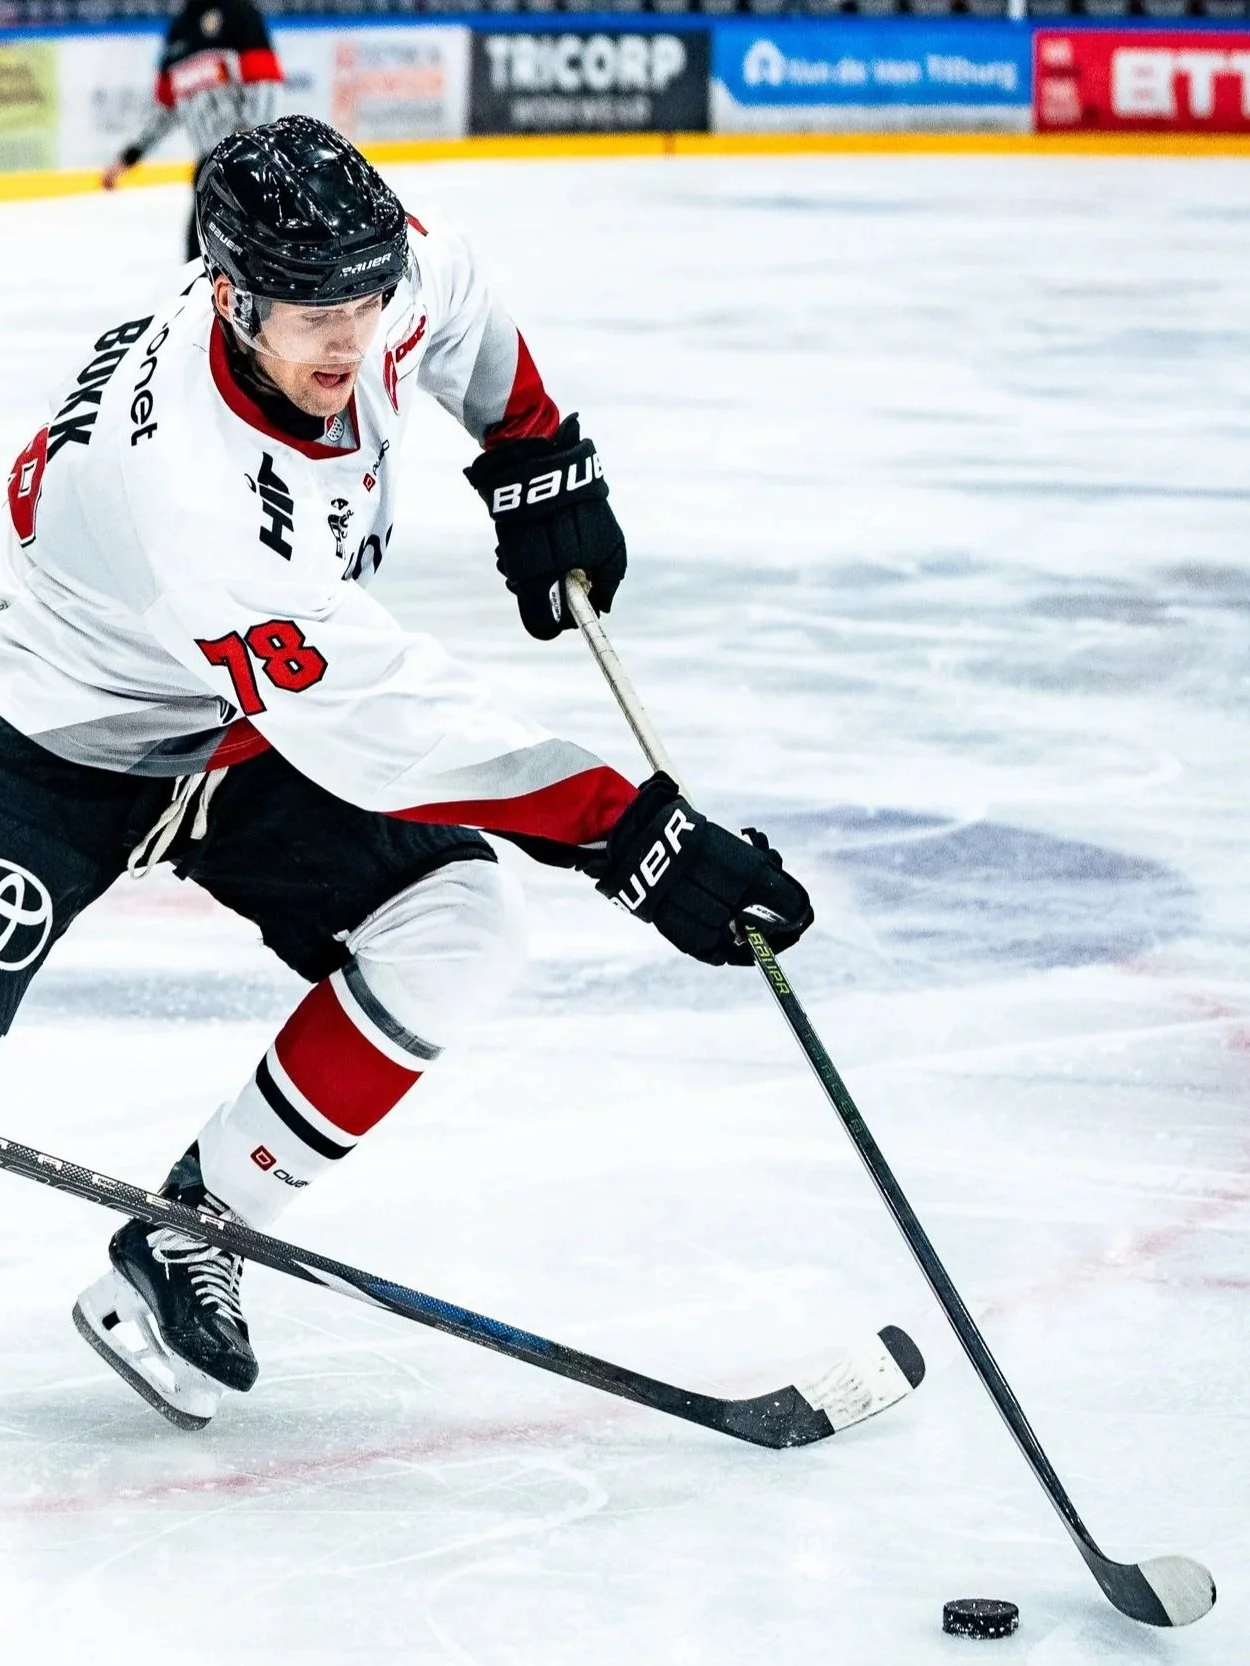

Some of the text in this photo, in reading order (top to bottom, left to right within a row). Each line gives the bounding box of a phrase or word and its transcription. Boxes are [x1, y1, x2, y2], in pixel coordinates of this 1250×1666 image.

[484, 33, 687, 92] TRICORP
[130, 322, 170, 447] onet
[193, 618, 329, 717] 78
